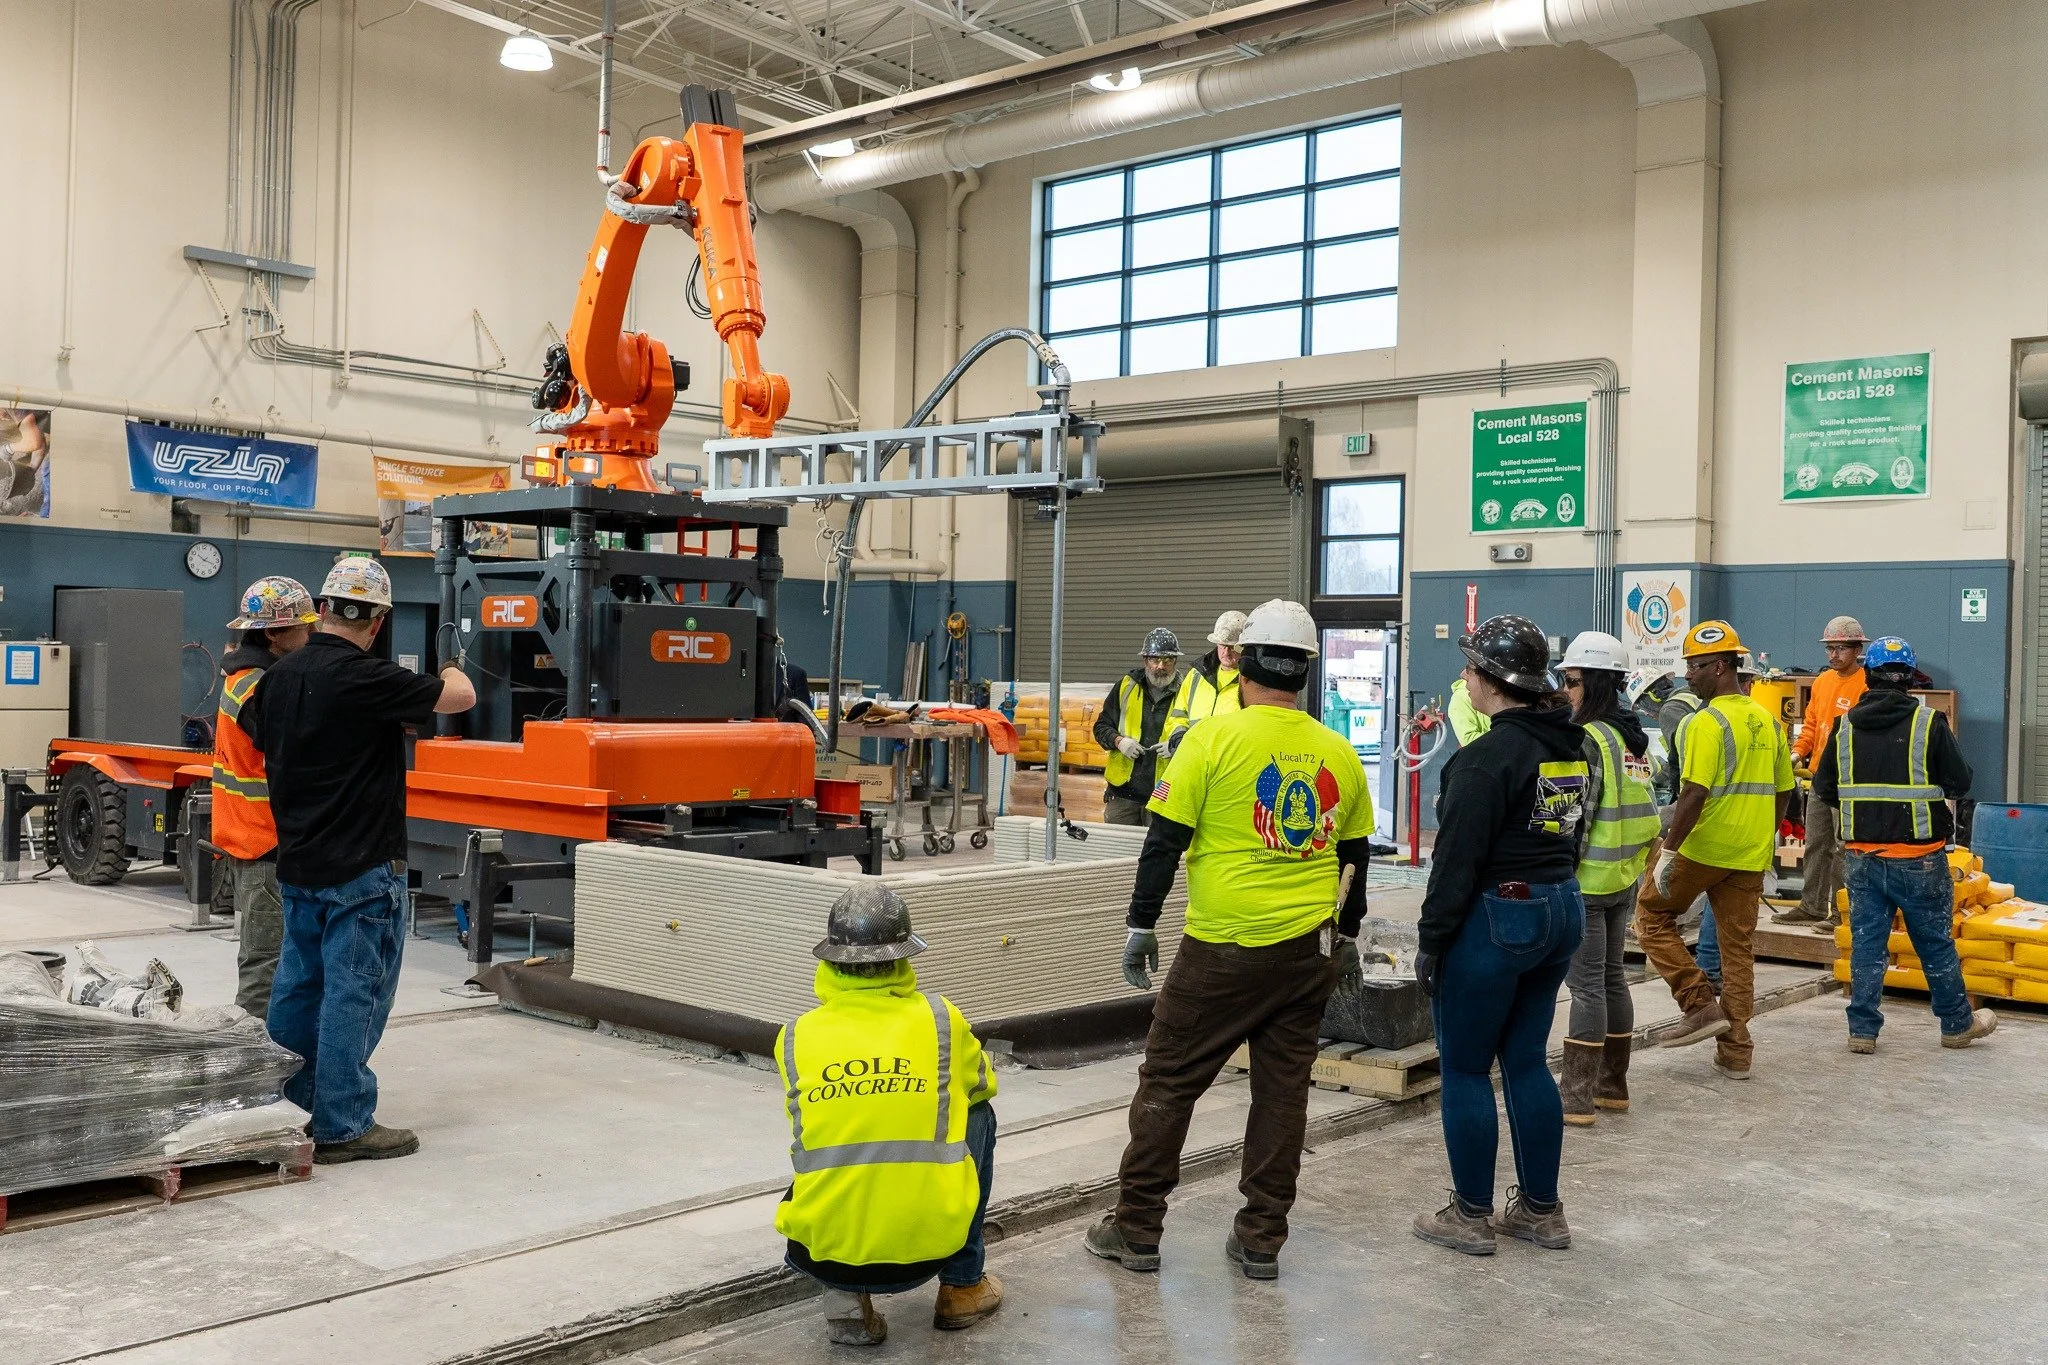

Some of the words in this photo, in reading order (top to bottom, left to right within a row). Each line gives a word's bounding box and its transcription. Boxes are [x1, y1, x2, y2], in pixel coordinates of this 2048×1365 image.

[702, 227, 717, 279] KUKA
[1792, 369, 1853, 386] Cement
[1858, 365, 1924, 380] Masons
[1817, 386, 1860, 402] Local
[1866, 384, 1895, 398] 528
[1478, 416, 1526, 430] Cement
[1531, 412, 1582, 426] Masons
[1847, 416, 1890, 424] technicians
[1498, 431, 1532, 444] Local
[1536, 429, 1560, 442] 528
[1790, 430, 1824, 440] providing
[1826, 429, 1851, 437] quality
[1853, 427, 1886, 435] concrete
[1888, 424, 1922, 433] finishing
[1348, 436, 1365, 452] EXIT
[1810, 440, 1821, 448] for
[1848, 438, 1866, 446] solid
[377, 462, 407, 473] SINGLE
[409, 465, 445, 476] SOURCE
[1522, 457, 1556, 465] technicians
[377, 471, 424, 485] SOLUTIONS
[1476, 470, 1504, 478] providing
[1506, 468, 1525, 476] quality
[1555, 465, 1581, 473] finishing
[153, 476, 176, 486] YOUR
[178, 480, 210, 491] FLOOR.
[236, 485, 272, 496] PROMISE.
[1538, 476, 1564, 484] product.
[492, 600, 526, 623] RIC
[668, 635, 714, 659] RIC
[1280, 752, 1302, 763] Local
[1304, 754, 1315, 763] 72
[821, 1057, 911, 1083] COLE
[808, 1077, 927, 1103] CONCRETE
